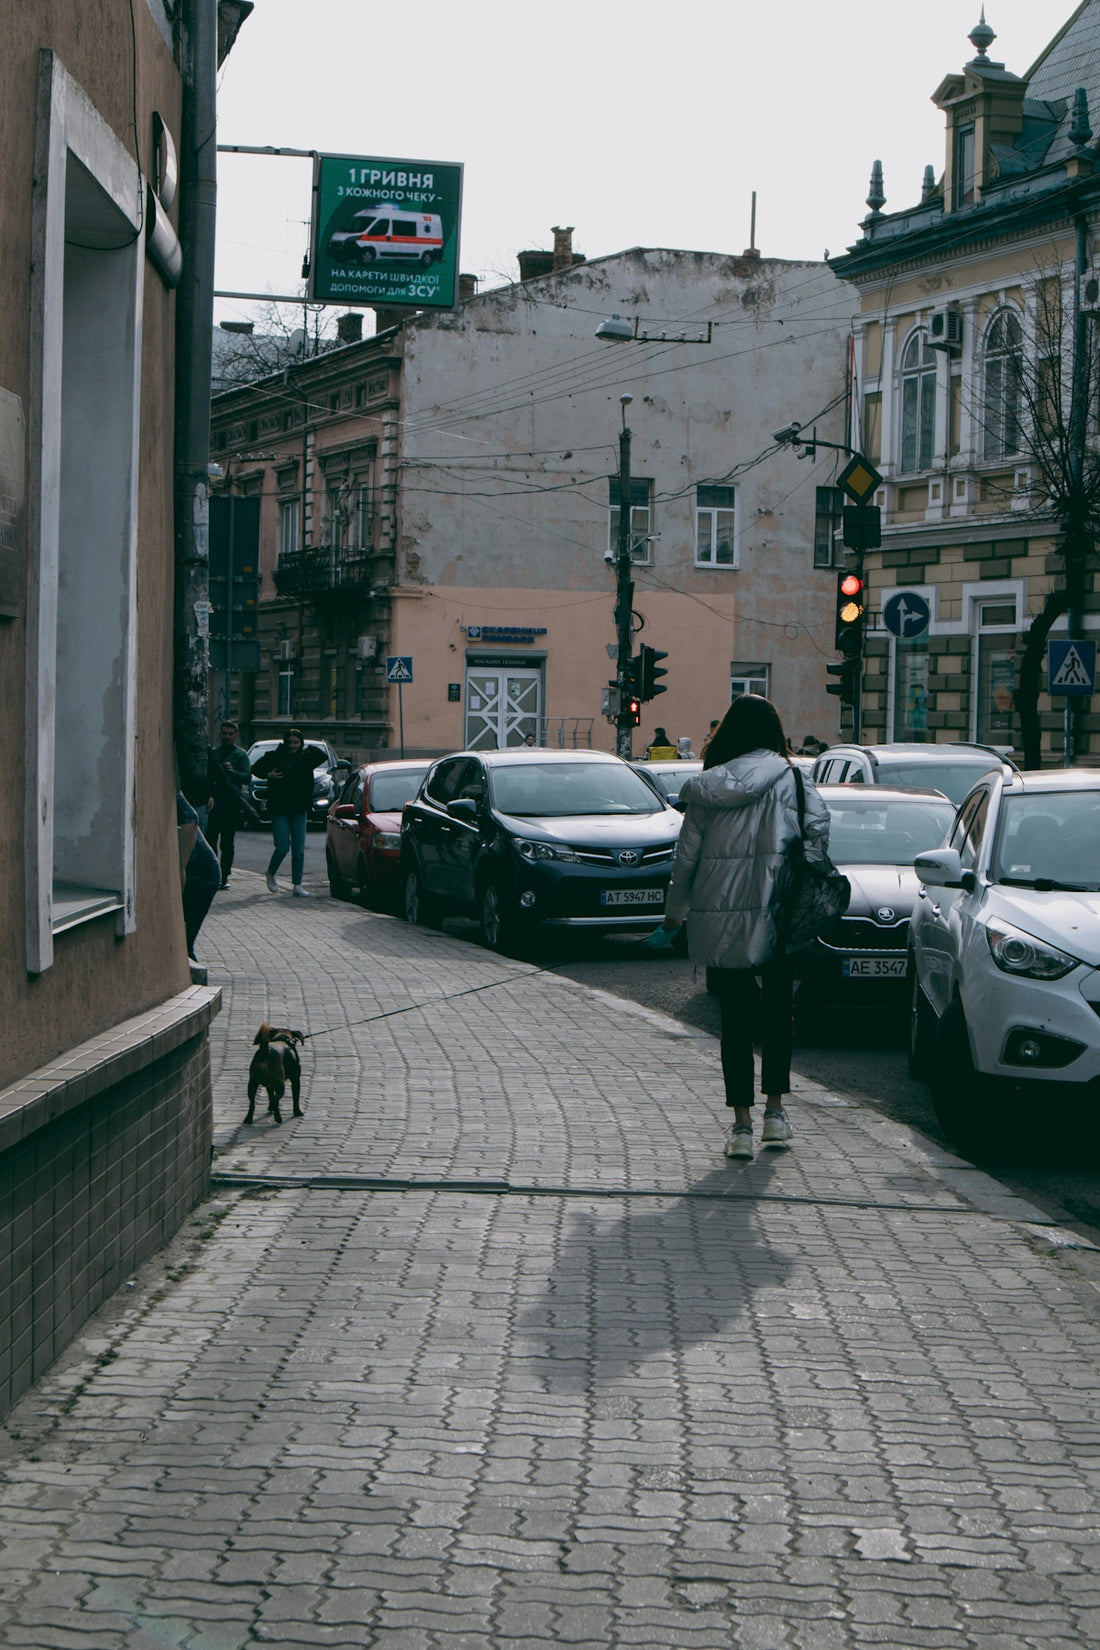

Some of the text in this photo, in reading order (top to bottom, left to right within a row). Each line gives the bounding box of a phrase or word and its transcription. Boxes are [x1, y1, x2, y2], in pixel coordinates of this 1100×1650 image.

[349, 169, 434, 189] 1 ГРИВНЯ
[346, 187, 404, 200] КОЖНОГО
[406, 191, 435, 203] ЧЕКУ
[331, 269, 440, 285] НА КАРЕТИ ШВИДКОЇ
[330, 283, 386, 295] ДОПОМОГИ
[607, 890, 662, 903] AT 5947 HC
[850, 961, 905, 974] AE 3547
